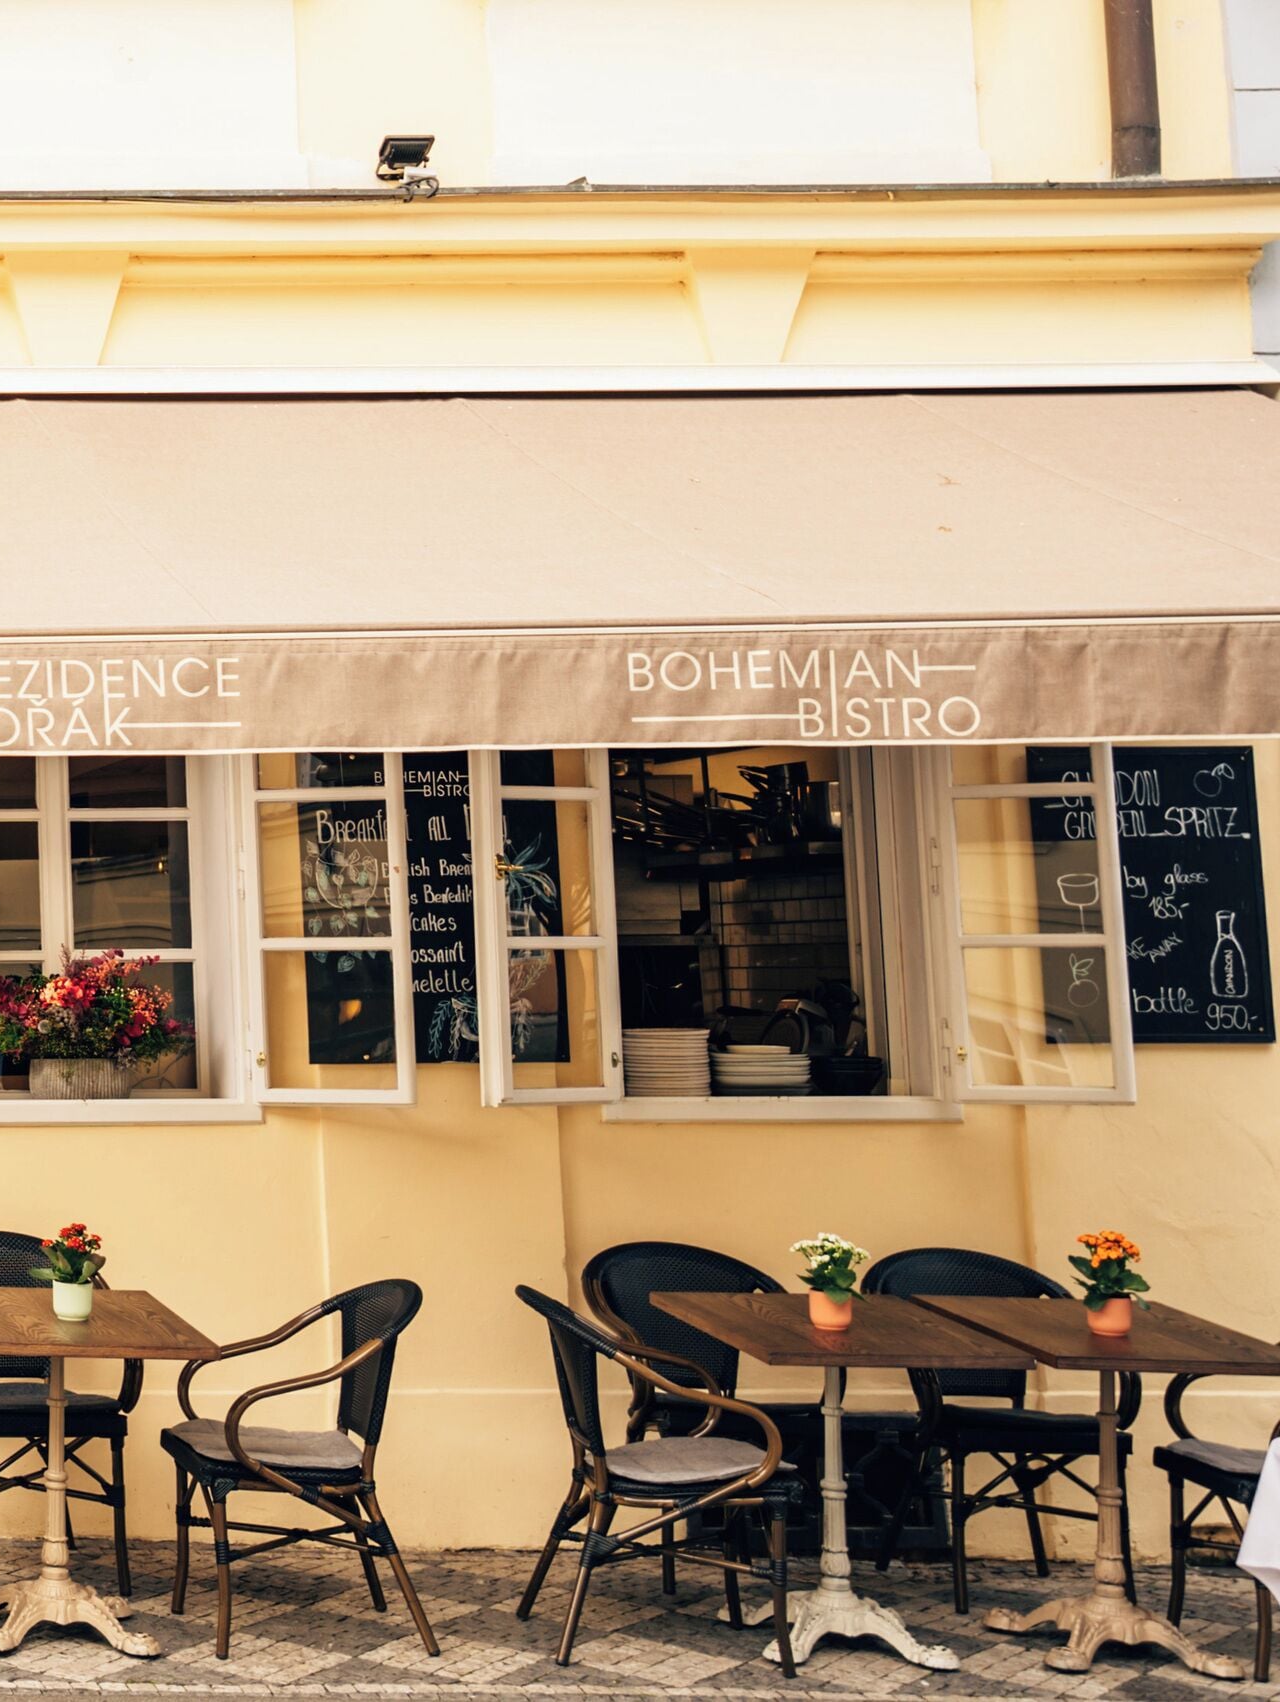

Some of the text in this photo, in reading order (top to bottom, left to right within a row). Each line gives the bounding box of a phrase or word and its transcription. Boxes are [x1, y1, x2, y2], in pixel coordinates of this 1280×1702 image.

[627, 649, 922, 692] BOHEMIAN
[798, 695, 981, 738] BISTRO
[374, 771, 459, 784] BHEMIAN
[1123, 864, 1208, 898] by glass
[1132, 986, 1200, 1013] bottle
